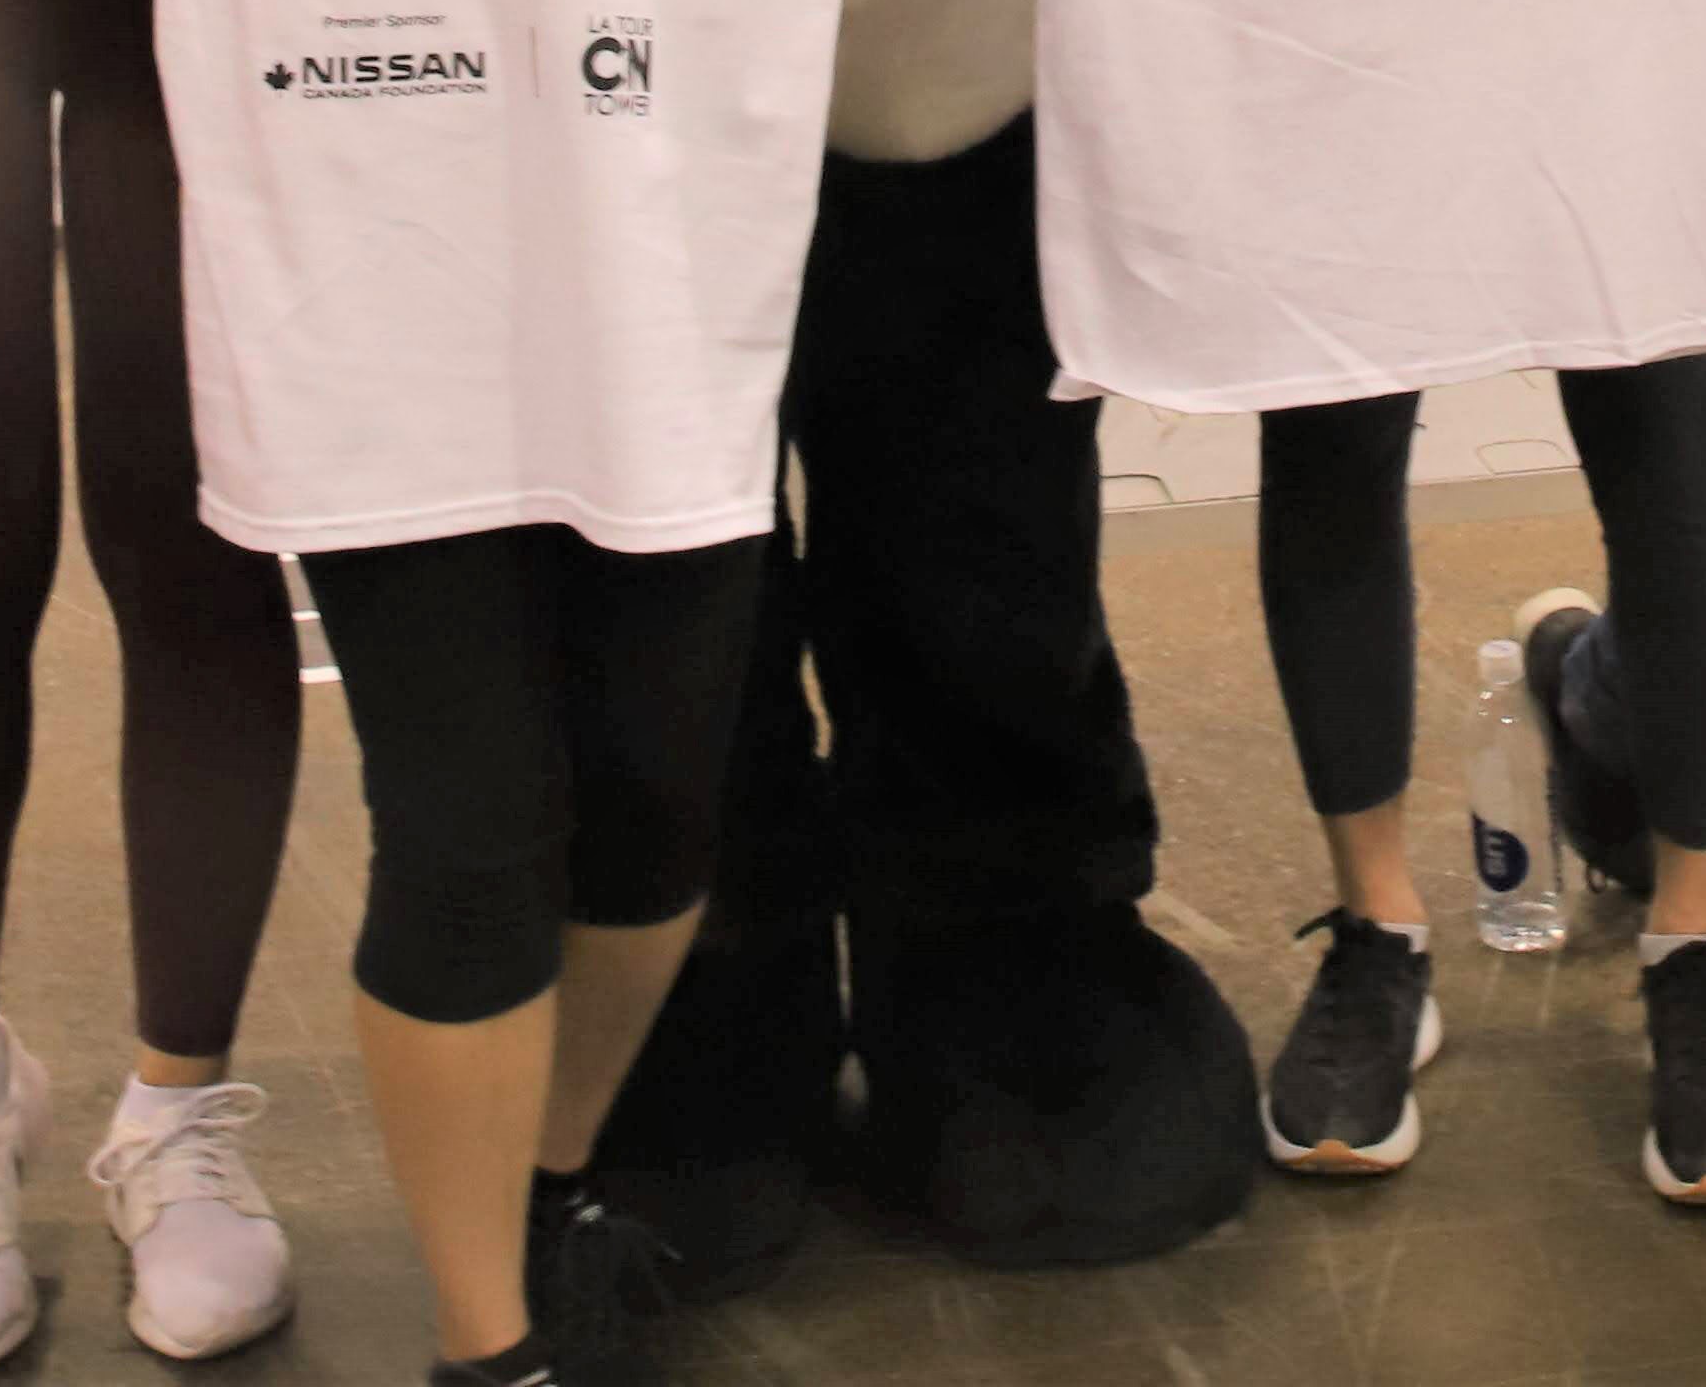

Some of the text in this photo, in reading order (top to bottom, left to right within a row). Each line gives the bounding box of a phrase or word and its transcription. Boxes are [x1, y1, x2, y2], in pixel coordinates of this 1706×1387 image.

[386, 13, 446, 28] Sponsor
[302, 50, 487, 85] NISSAN
[582, 36, 653, 93] CN
